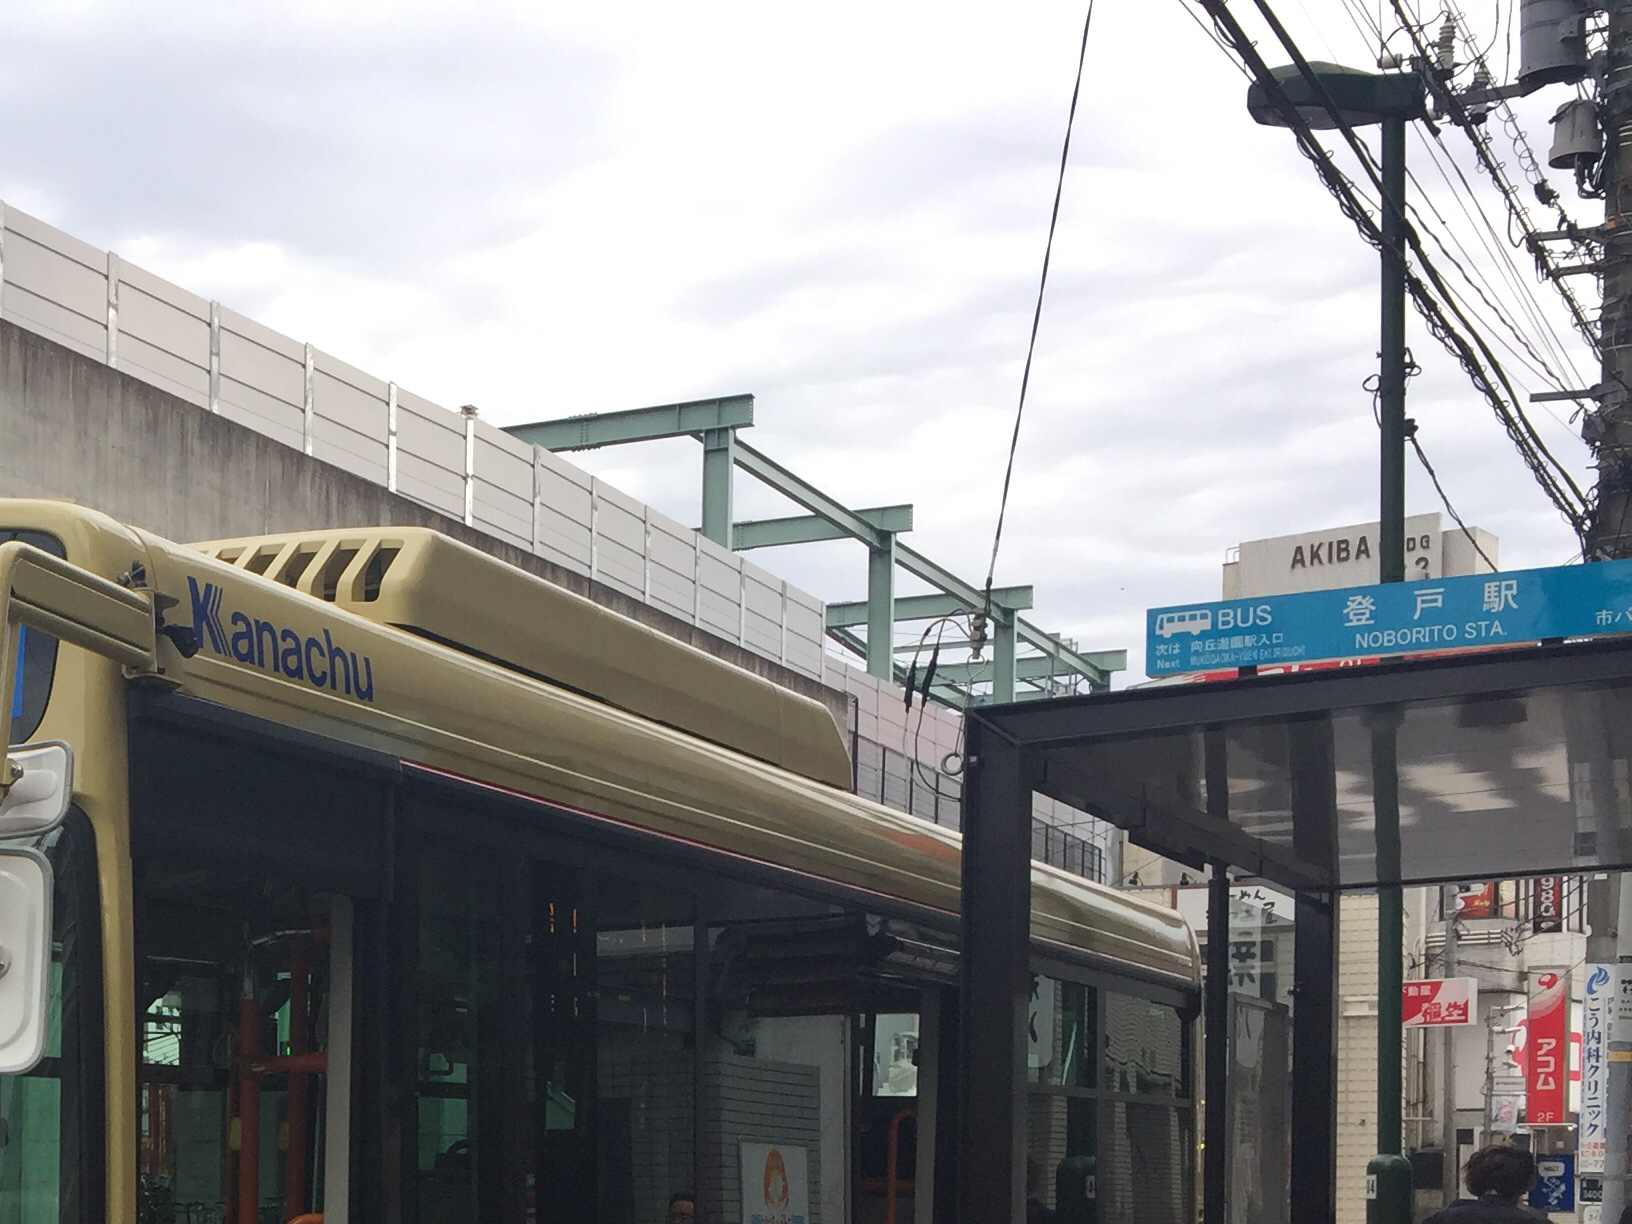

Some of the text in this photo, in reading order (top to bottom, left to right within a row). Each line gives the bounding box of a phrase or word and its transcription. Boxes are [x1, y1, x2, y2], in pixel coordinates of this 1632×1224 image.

[1290, 535, 1371, 570] AKIBA
[1218, 604, 1273, 630] BUS
[1343, 579, 1519, 627] 登戸駅
[186, 575, 375, 702] Kanachu
[1155, 642, 1181, 656] 次は
[1355, 619, 1509, 649] NOBORITO STA.
[1156, 658, 1180, 670] Next
[1536, 1038, 1557, 1090] アコム
[1585, 996, 1603, 1138] こう内科クリニック
[1537, 1112, 1555, 1123] 2F
